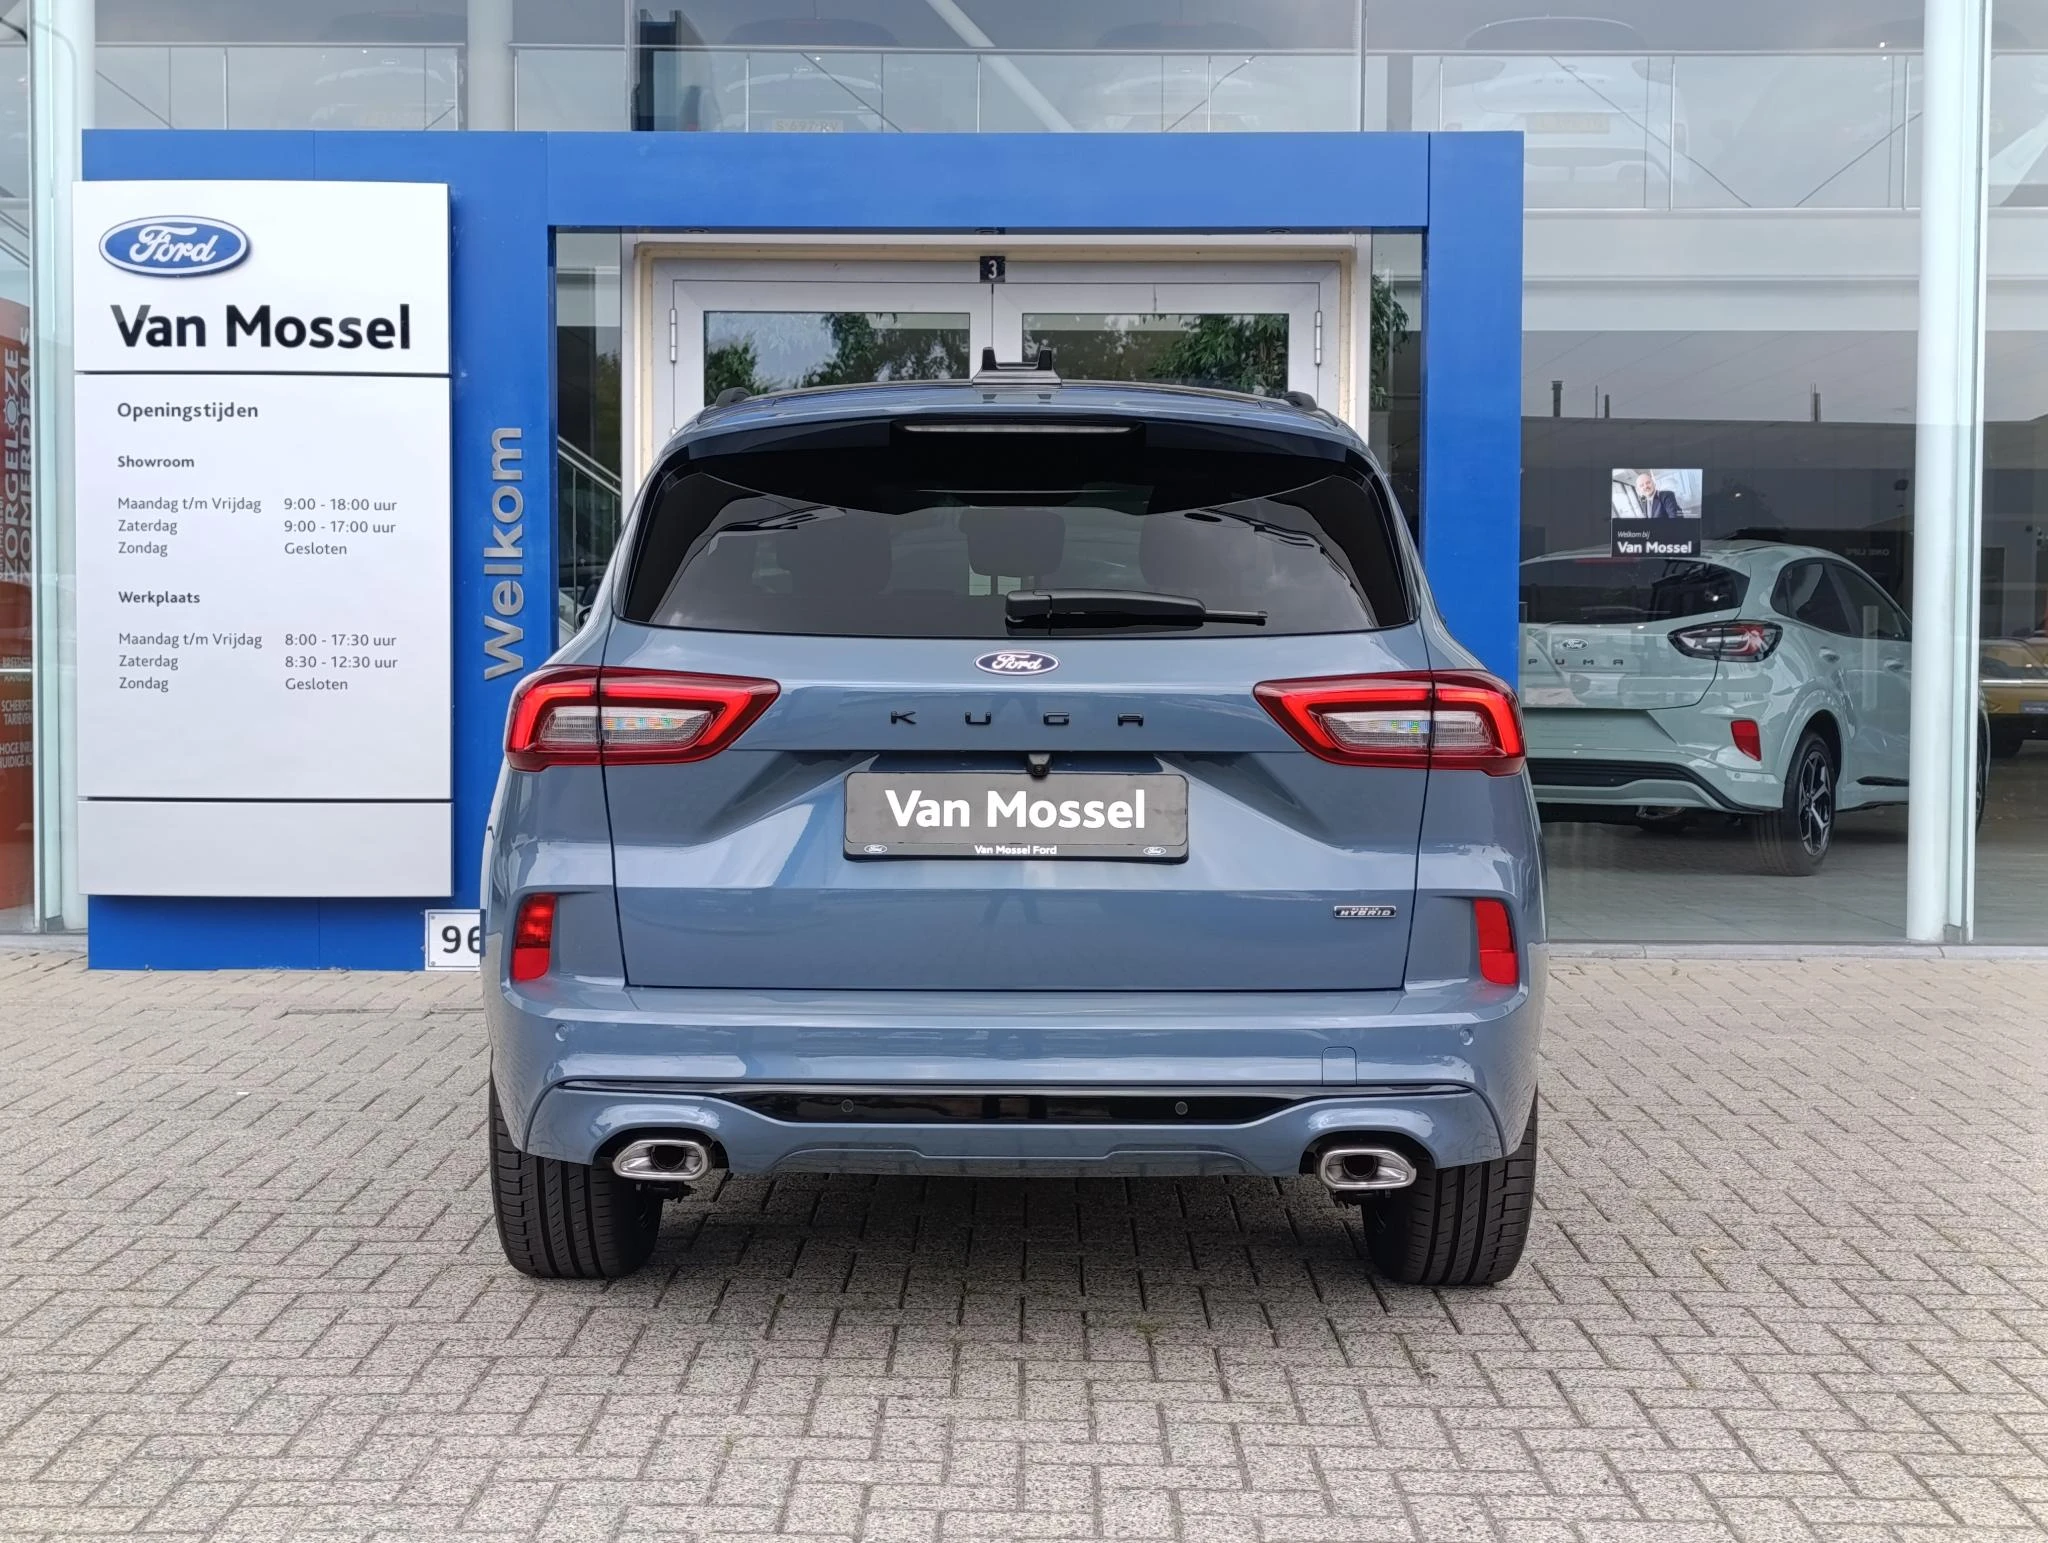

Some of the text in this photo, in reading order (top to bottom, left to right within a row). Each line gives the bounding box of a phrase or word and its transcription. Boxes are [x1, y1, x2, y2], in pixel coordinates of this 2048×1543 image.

[129, 225, 219, 262] Ford
[989, 259, 998, 279] 3
[110, 304, 411, 350] Van Mossel
[117, 402, 259, 423] Openingstijden
[117, 454, 195, 468] Showroom
[117, 496, 179, 514] Maandag
[182, 496, 208, 510] t/m
[212, 496, 262, 514] Vrijdag
[284, 497, 316, 511] 9:00
[330, 498, 370, 511] 18:00
[373, 502, 398, 511] uur
[118, 519, 178, 536] Zaterdag
[284, 520, 316, 533] 9:00
[330, 520, 369, 533] 17:00
[372, 524, 397, 534] uur
[118, 541, 348, 558] Zondag Gesloten
[484, 427, 524, 680] Welkom
[1617, 541, 1692, 554] Van Mossel
[118, 590, 201, 608] Werkplaats
[119, 632, 180, 649] Maandag
[183, 632, 209, 646] t/m
[212, 632, 263, 650] Vrijdag
[284, 633, 317, 646] 8:00
[331, 633, 369, 647] 17:30
[373, 637, 397, 647] uur
[119, 654, 179, 671] Zaterdag
[285, 655, 317, 668] 8:30
[331, 655, 371, 669] 12:30
[374, 659, 398, 669] uur
[119, 676, 348, 693] Zondag Gesloten
[890, 711, 1145, 728] KUGA
[886, 789, 1145, 829] Van Mossel
[974, 844, 1057, 855] Van Mossel Ford
